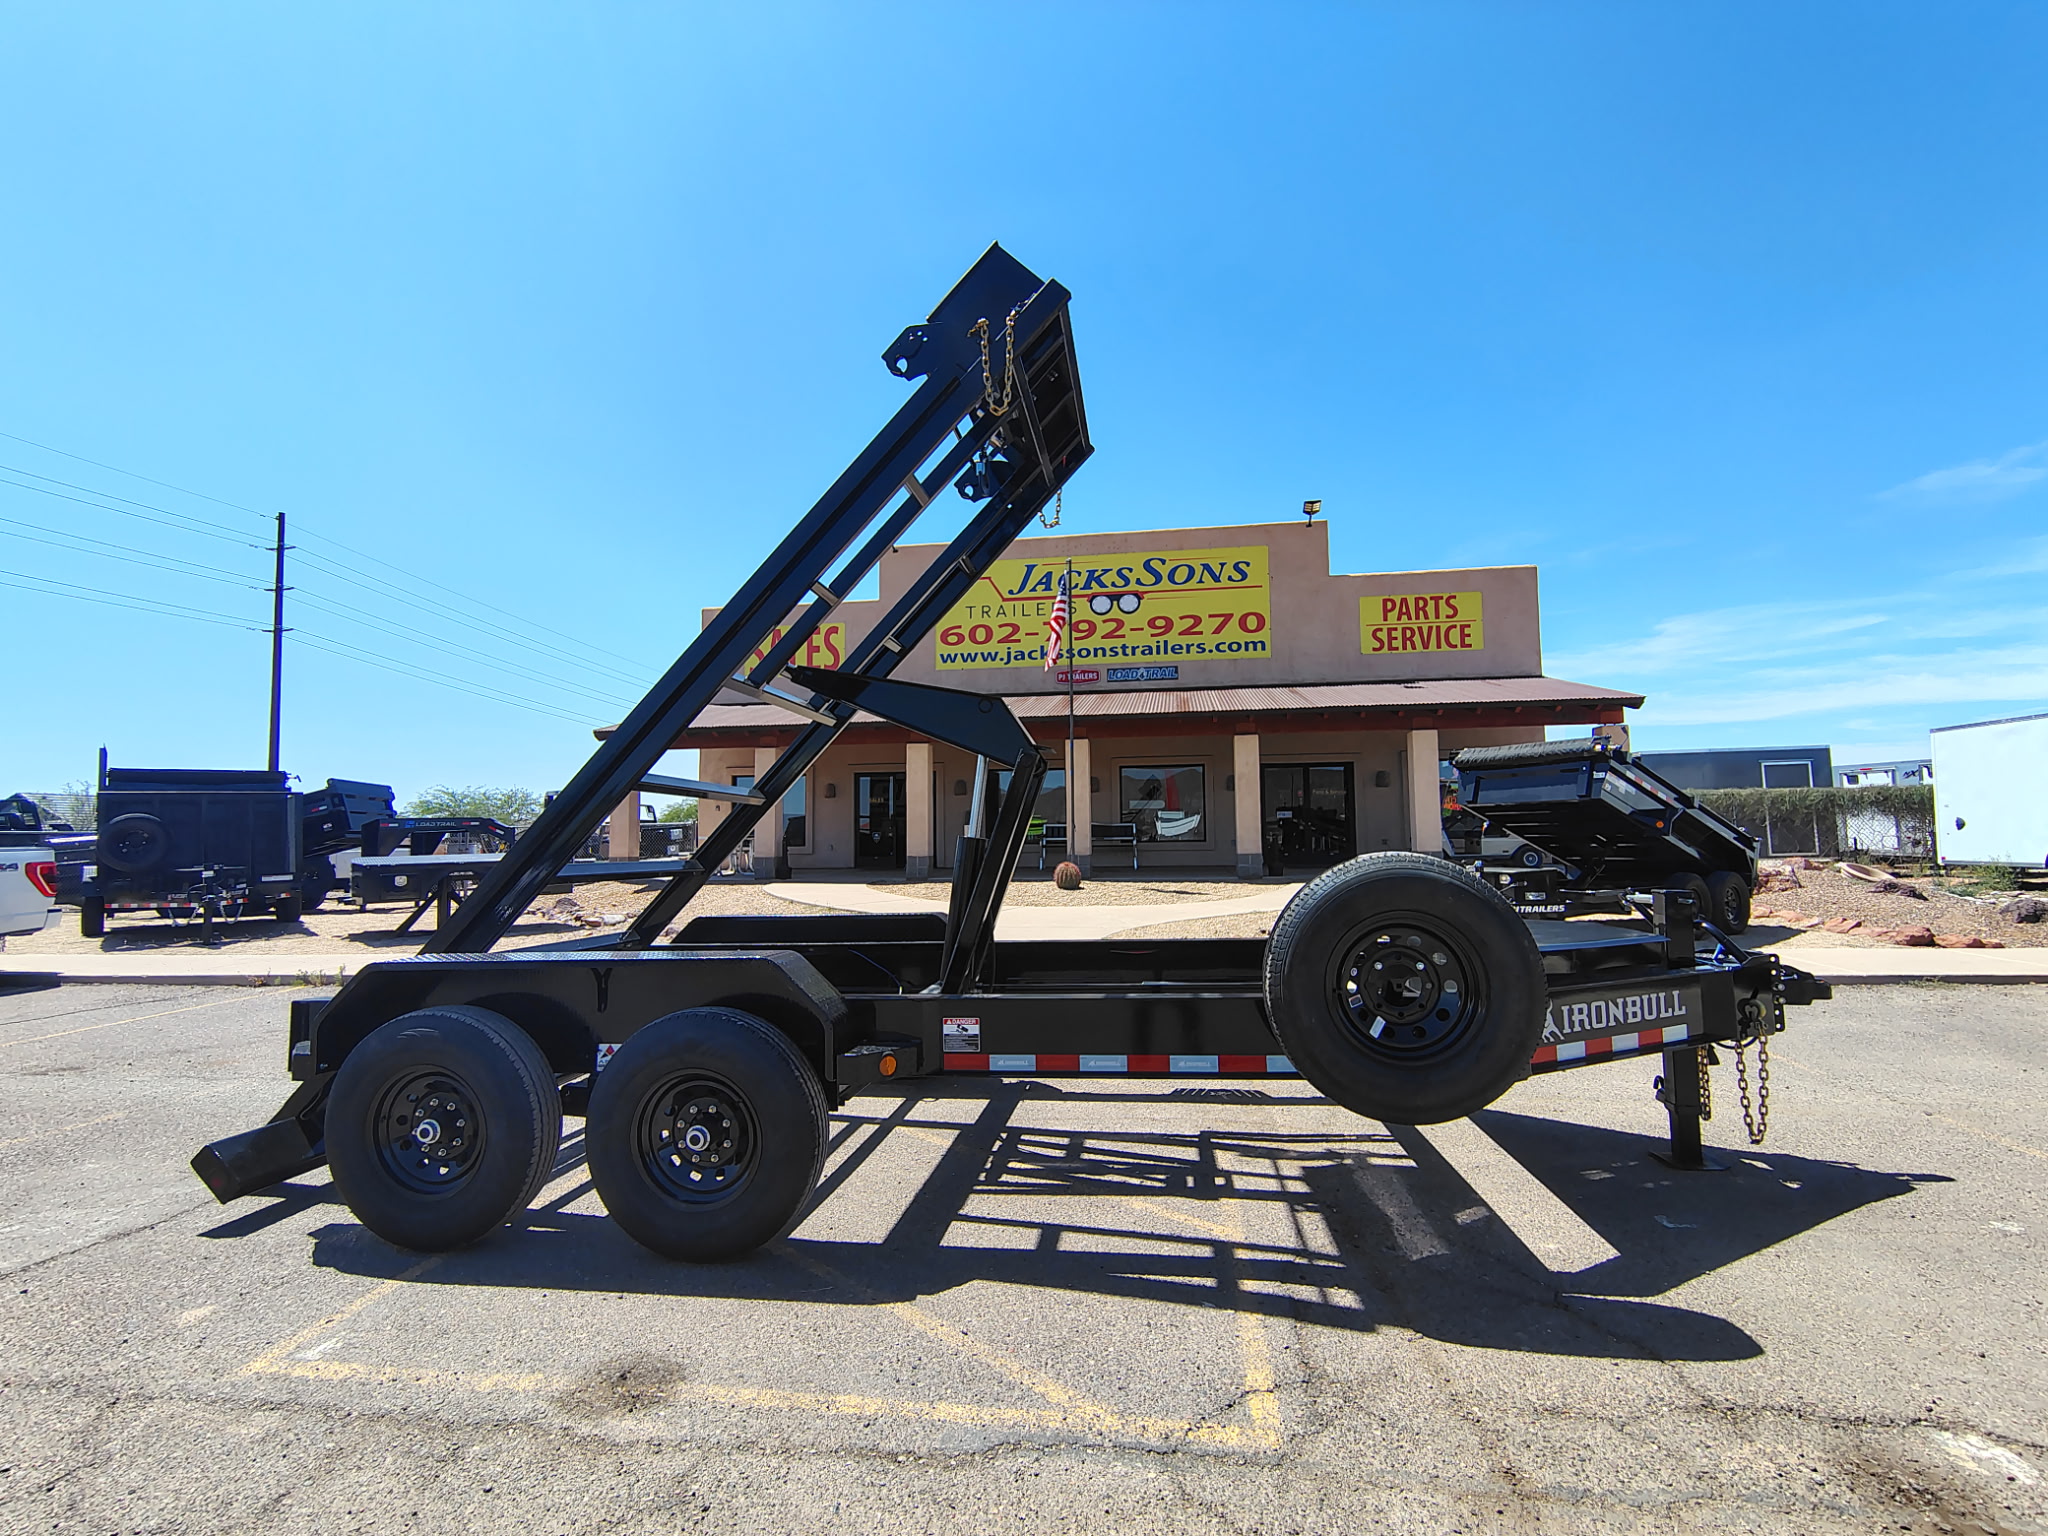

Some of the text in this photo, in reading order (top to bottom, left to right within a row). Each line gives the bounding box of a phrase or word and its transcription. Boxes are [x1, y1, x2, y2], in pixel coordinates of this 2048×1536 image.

[965, 601, 1077, 619] TRAILES
[1382, 594, 1459, 622] PARTS
[1371, 623, 1473, 652] SERVICE
[1107, 667, 1177, 681] LOAD TRAIL
[1561, 990, 1687, 1034] IRONBULL
